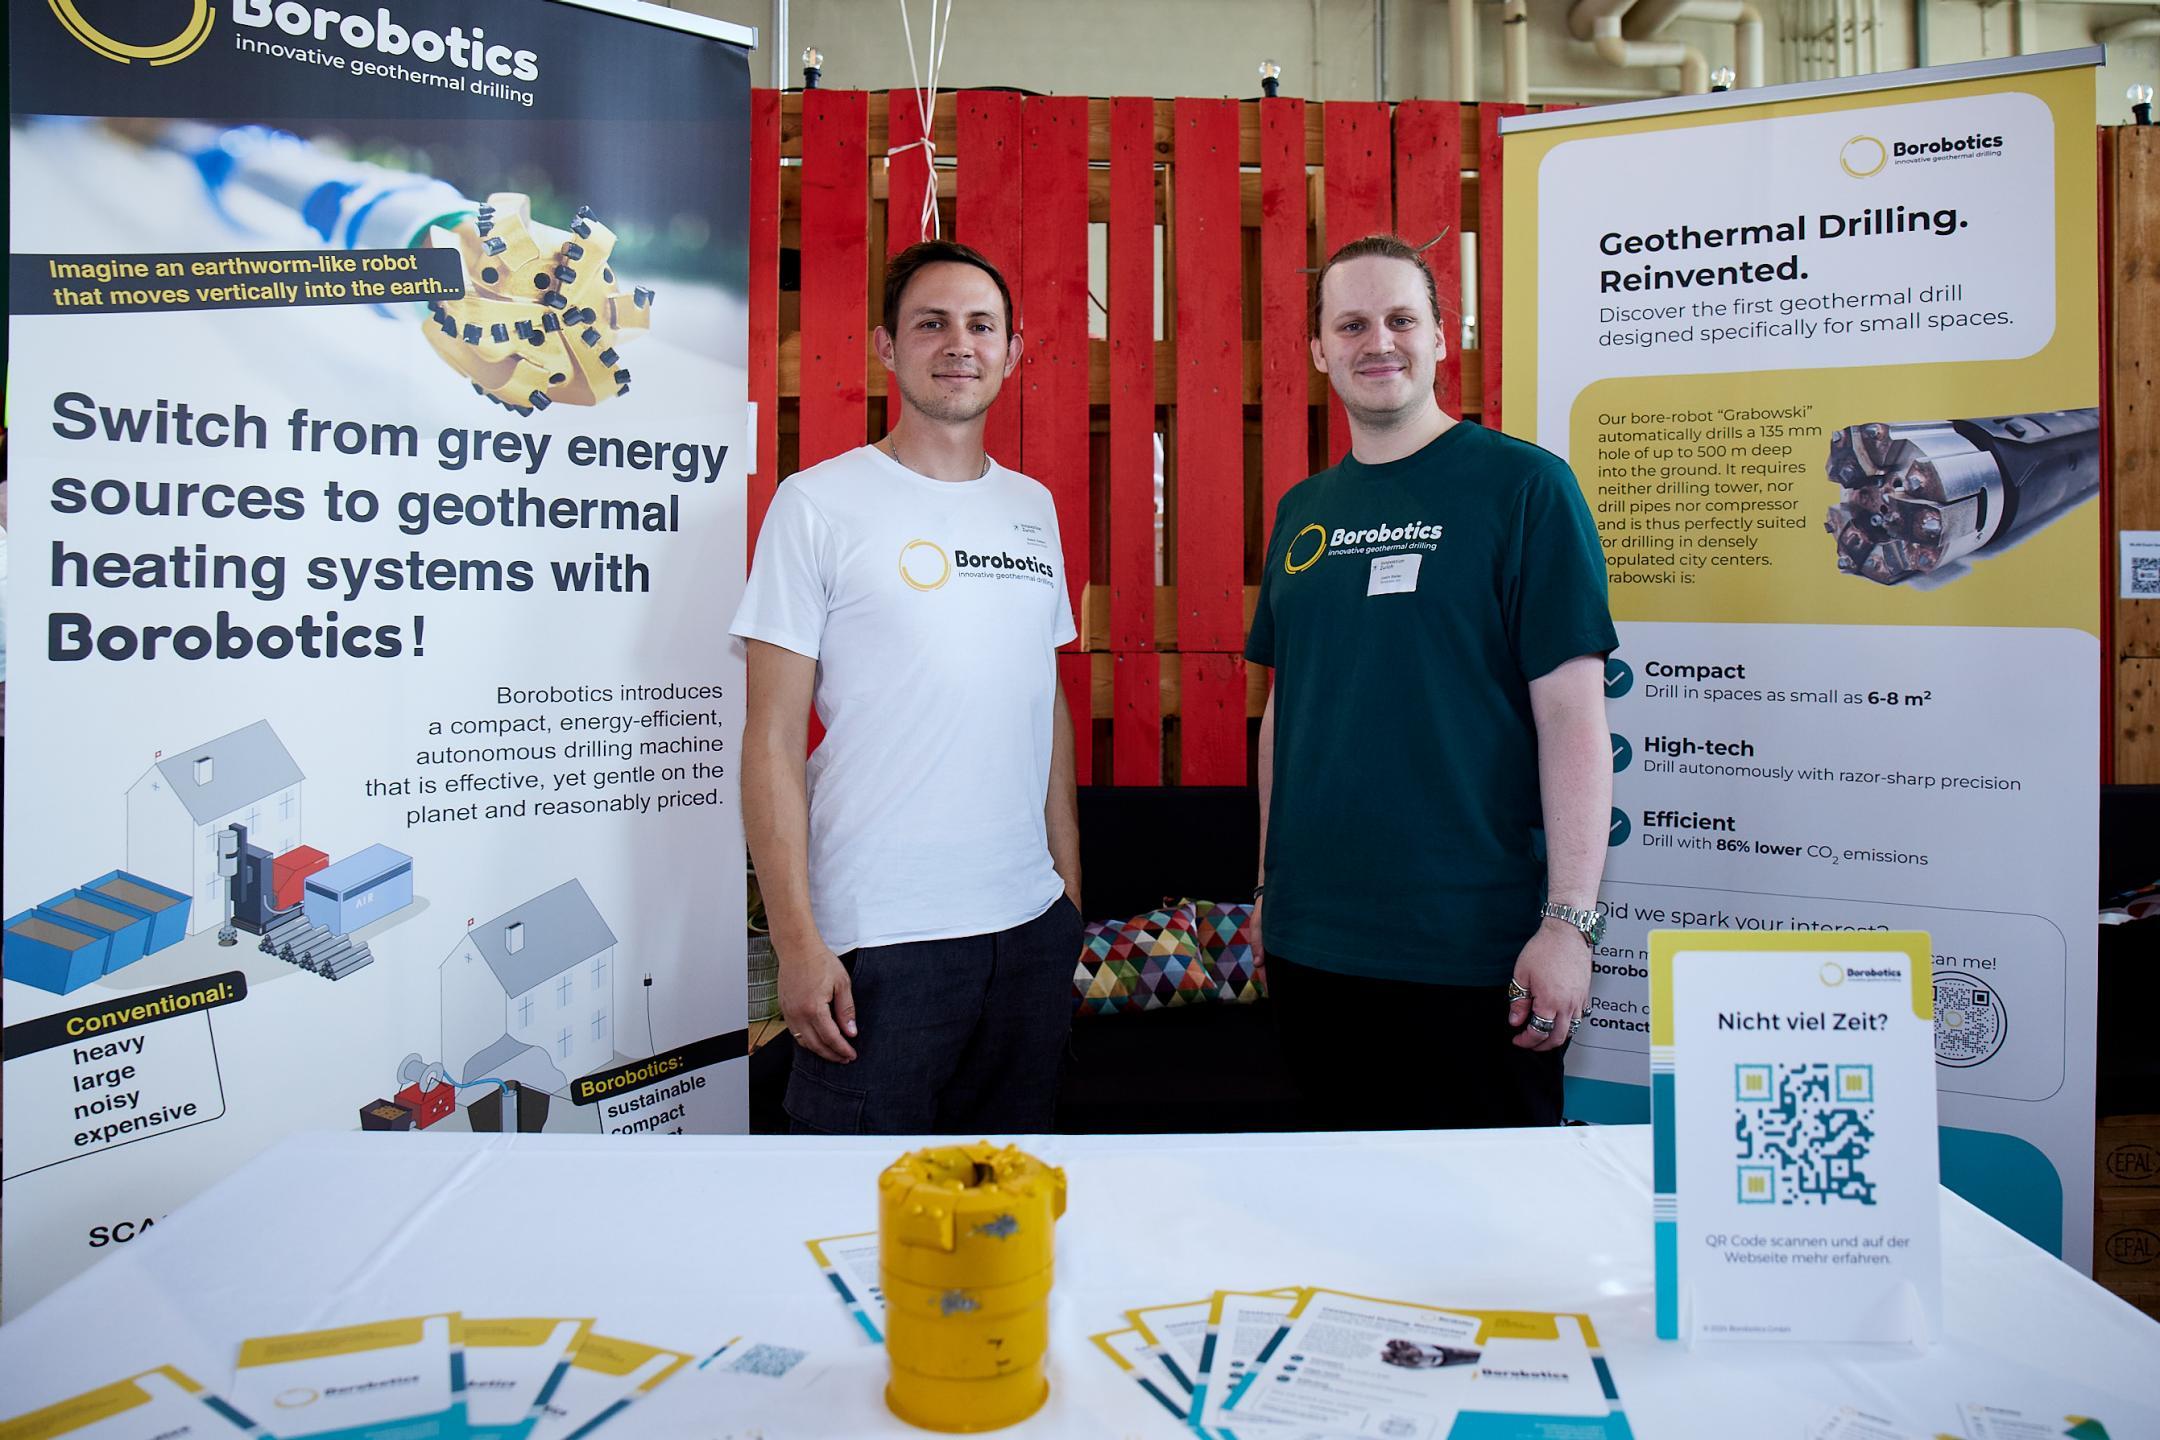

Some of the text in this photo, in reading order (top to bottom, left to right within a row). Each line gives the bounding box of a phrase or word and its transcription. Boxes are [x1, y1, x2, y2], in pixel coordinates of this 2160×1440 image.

[233, 0, 538, 80] Borobotics
[237, 34, 533, 106] innovative geothermal drilling
[1894, 134, 2002, 156] Borobotics
[1600, 206, 1967, 255] Geothermal Drilling.
[50, 255, 417, 282] Imagine an earthworm-like robot
[1601, 255, 1808, 293] Reinvented.
[53, 288, 103, 305] that
[110, 289, 190, 304] moves
[196, 282, 298, 302] vertically
[305, 282, 345, 297] into
[351, 280, 384, 296] the
[1601, 284, 1961, 322] Discover the first geothermal drill
[1599, 312, 2013, 347] designed specifically for small spaces.
[1599, 414, 1626, 425] Our
[1632, 411, 1712, 424] bore-robot
[53, 392, 728, 483] Switch from grey energy
[1599, 425, 1821, 442] automatically drills a 135 mm
[1599, 444, 1792, 460] hole of up to 500 m deep
[1599, 461, 1806, 479] into the ground. It requires
[1599, 482, 1793, 496] neither drilling tower, nor
[51, 478, 678, 535] sources to geothermal
[1598, 500, 1798, 514] drill pipes nor compressor
[1330, 521, 1442, 546] Borobotics
[1599, 516, 1805, 532] and is thus perfectly suited
[1328, 541, 1438, 556] innovative geothermal drilling
[1622, 535, 1758, 550] drilling in densely
[52, 541, 649, 601] heating systems with
[955, 550, 1053, 577] Borobotics
[1605, 553, 1772, 568] opulated city centers.
[1610, 572, 1695, 583] rabowski is:
[1646, 662, 1745, 681] Compact
[498, 683, 722, 703] Borobotics introduces
[1646, 685, 1677, 698] Drill
[1685, 689, 1698, 698] in
[1704, 690, 1761, 702] spaces
[1767, 691, 1785, 701] as
[1791, 690, 1837, 703] small
[1844, 694, 1862, 704] as
[1868, 692, 1898, 705] 6-8
[429, 710, 721, 736] a compact, energy-efficient,
[417, 736, 723, 764] autonomous drilling machine
[1645, 736, 1753, 757] High-tech
[365, 763, 723, 796] that is effective, yet gentle on the
[1645, 760, 2020, 790] Drill autonomously with razor-sharp precision
[408, 789, 722, 828] planet and reasonably priced.
[1644, 811, 1735, 831] Efficient
[1643, 834, 1928, 865] Drill with 86% lower emissions
[1635, 908, 1665, 922] we
[1671, 910, 1730, 928] spark
[1592, 945, 1634, 959] Learn
[1963, 957, 1997, 970] me!
[65, 980, 237, 1038] Conventional:
[1591, 997, 1637, 1014] Reach
[1719, 1012, 1887, 1030] Nicht viel Zeit?
[74, 1036, 144, 1064] heavy
[74, 1066, 135, 1092] large
[581, 1055, 684, 1098] Borobotics:
[75, 1091, 139, 1119] noisy
[608, 1077, 705, 1117] sustainable
[75, 1103, 196, 1146] expensive
[2115, 1152, 2153, 1173] EPAL
[1706, 1235, 1910, 1248] QR Code scannen und auf der
[2114, 1237, 2153, 1257] EPAL
[1725, 1252, 1890, 1264] Webseite mehr erfahren.
